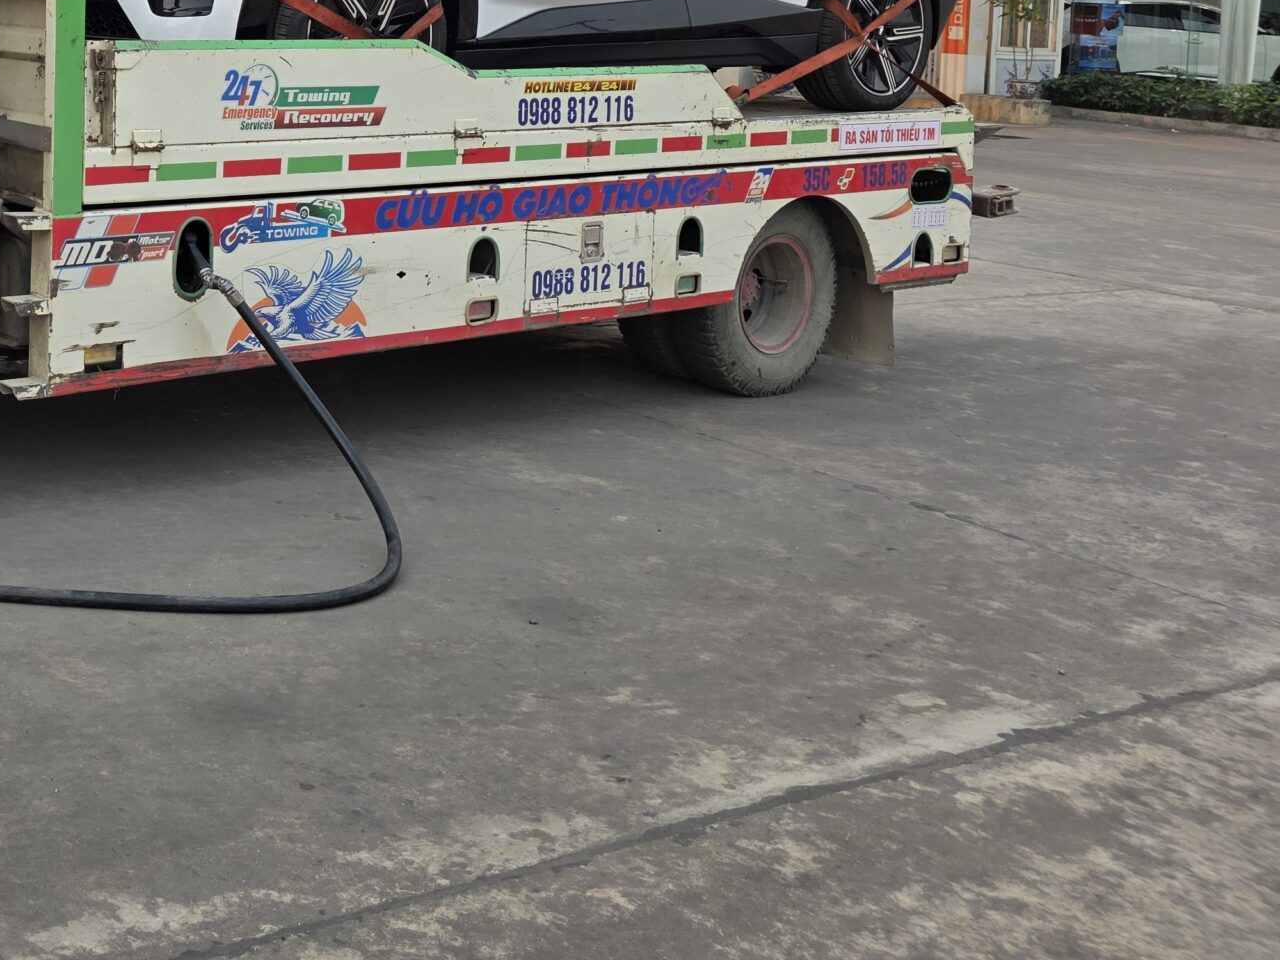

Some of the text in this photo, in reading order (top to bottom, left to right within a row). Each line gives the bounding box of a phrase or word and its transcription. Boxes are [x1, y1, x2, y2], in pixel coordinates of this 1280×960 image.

[524, 81, 570, 93] HOTLINE
[284, 88, 351, 105] Towing
[222, 106, 278, 121] Emergency
[283, 110, 375, 126] Recovery
[518, 95, 634, 126] 0988 812 116
[240, 120, 273, 131] Services
[881, 124, 894, 142] TỐI
[896, 122, 920, 141] THIỂU
[923, 127, 935, 140] 1M
[803, 166, 831, 192] 35C
[375, 173, 708, 232] CỨU HỘ GIAO THÔNG
[265, 226, 319, 239] TOWING
[140, 236, 171, 246] Motor
[532, 260, 646, 298] 0988 812 116
